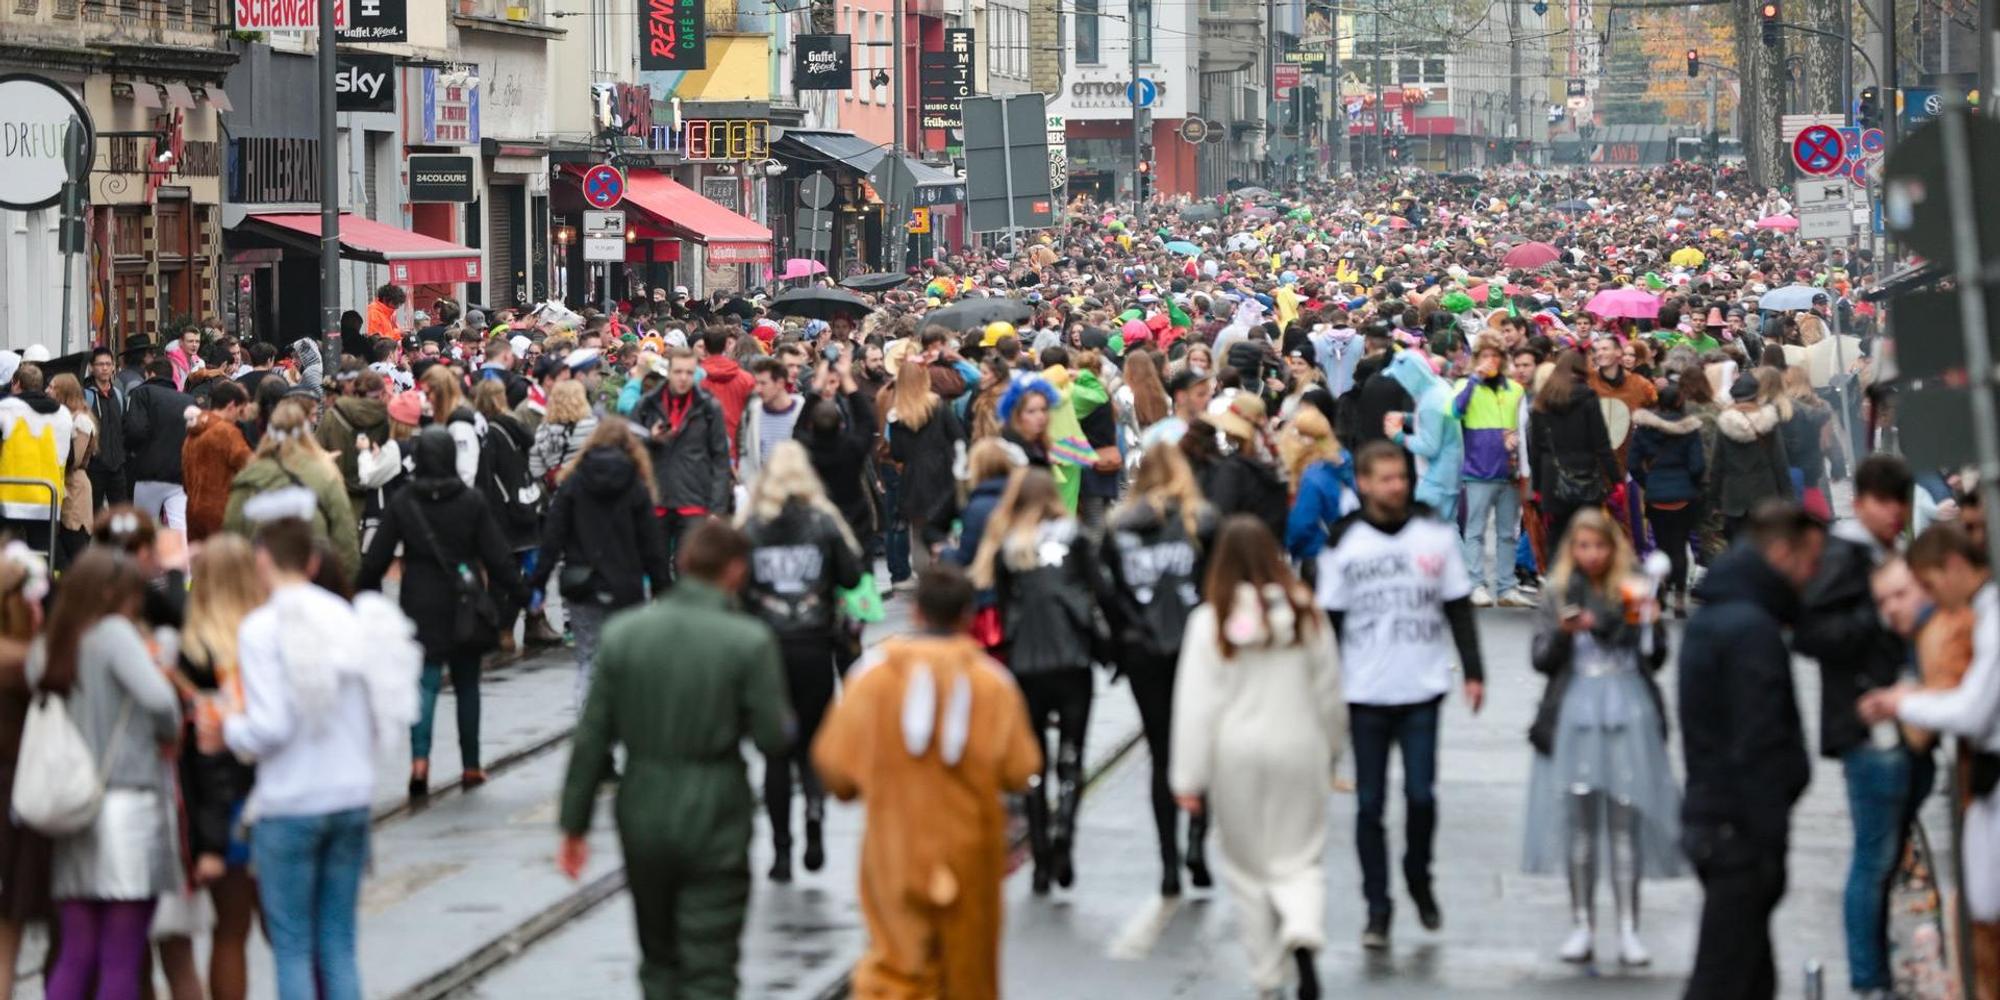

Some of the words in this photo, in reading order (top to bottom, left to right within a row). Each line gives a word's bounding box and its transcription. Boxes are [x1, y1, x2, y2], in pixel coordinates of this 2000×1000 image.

[237, 0, 345, 27] Schawara
[335, 66, 386, 99] sky
[1071, 81, 1167, 96] OTTOMS
[245, 138, 321, 202] HILLEBRAN
[416, 173, 467, 183] 24COLOURS
